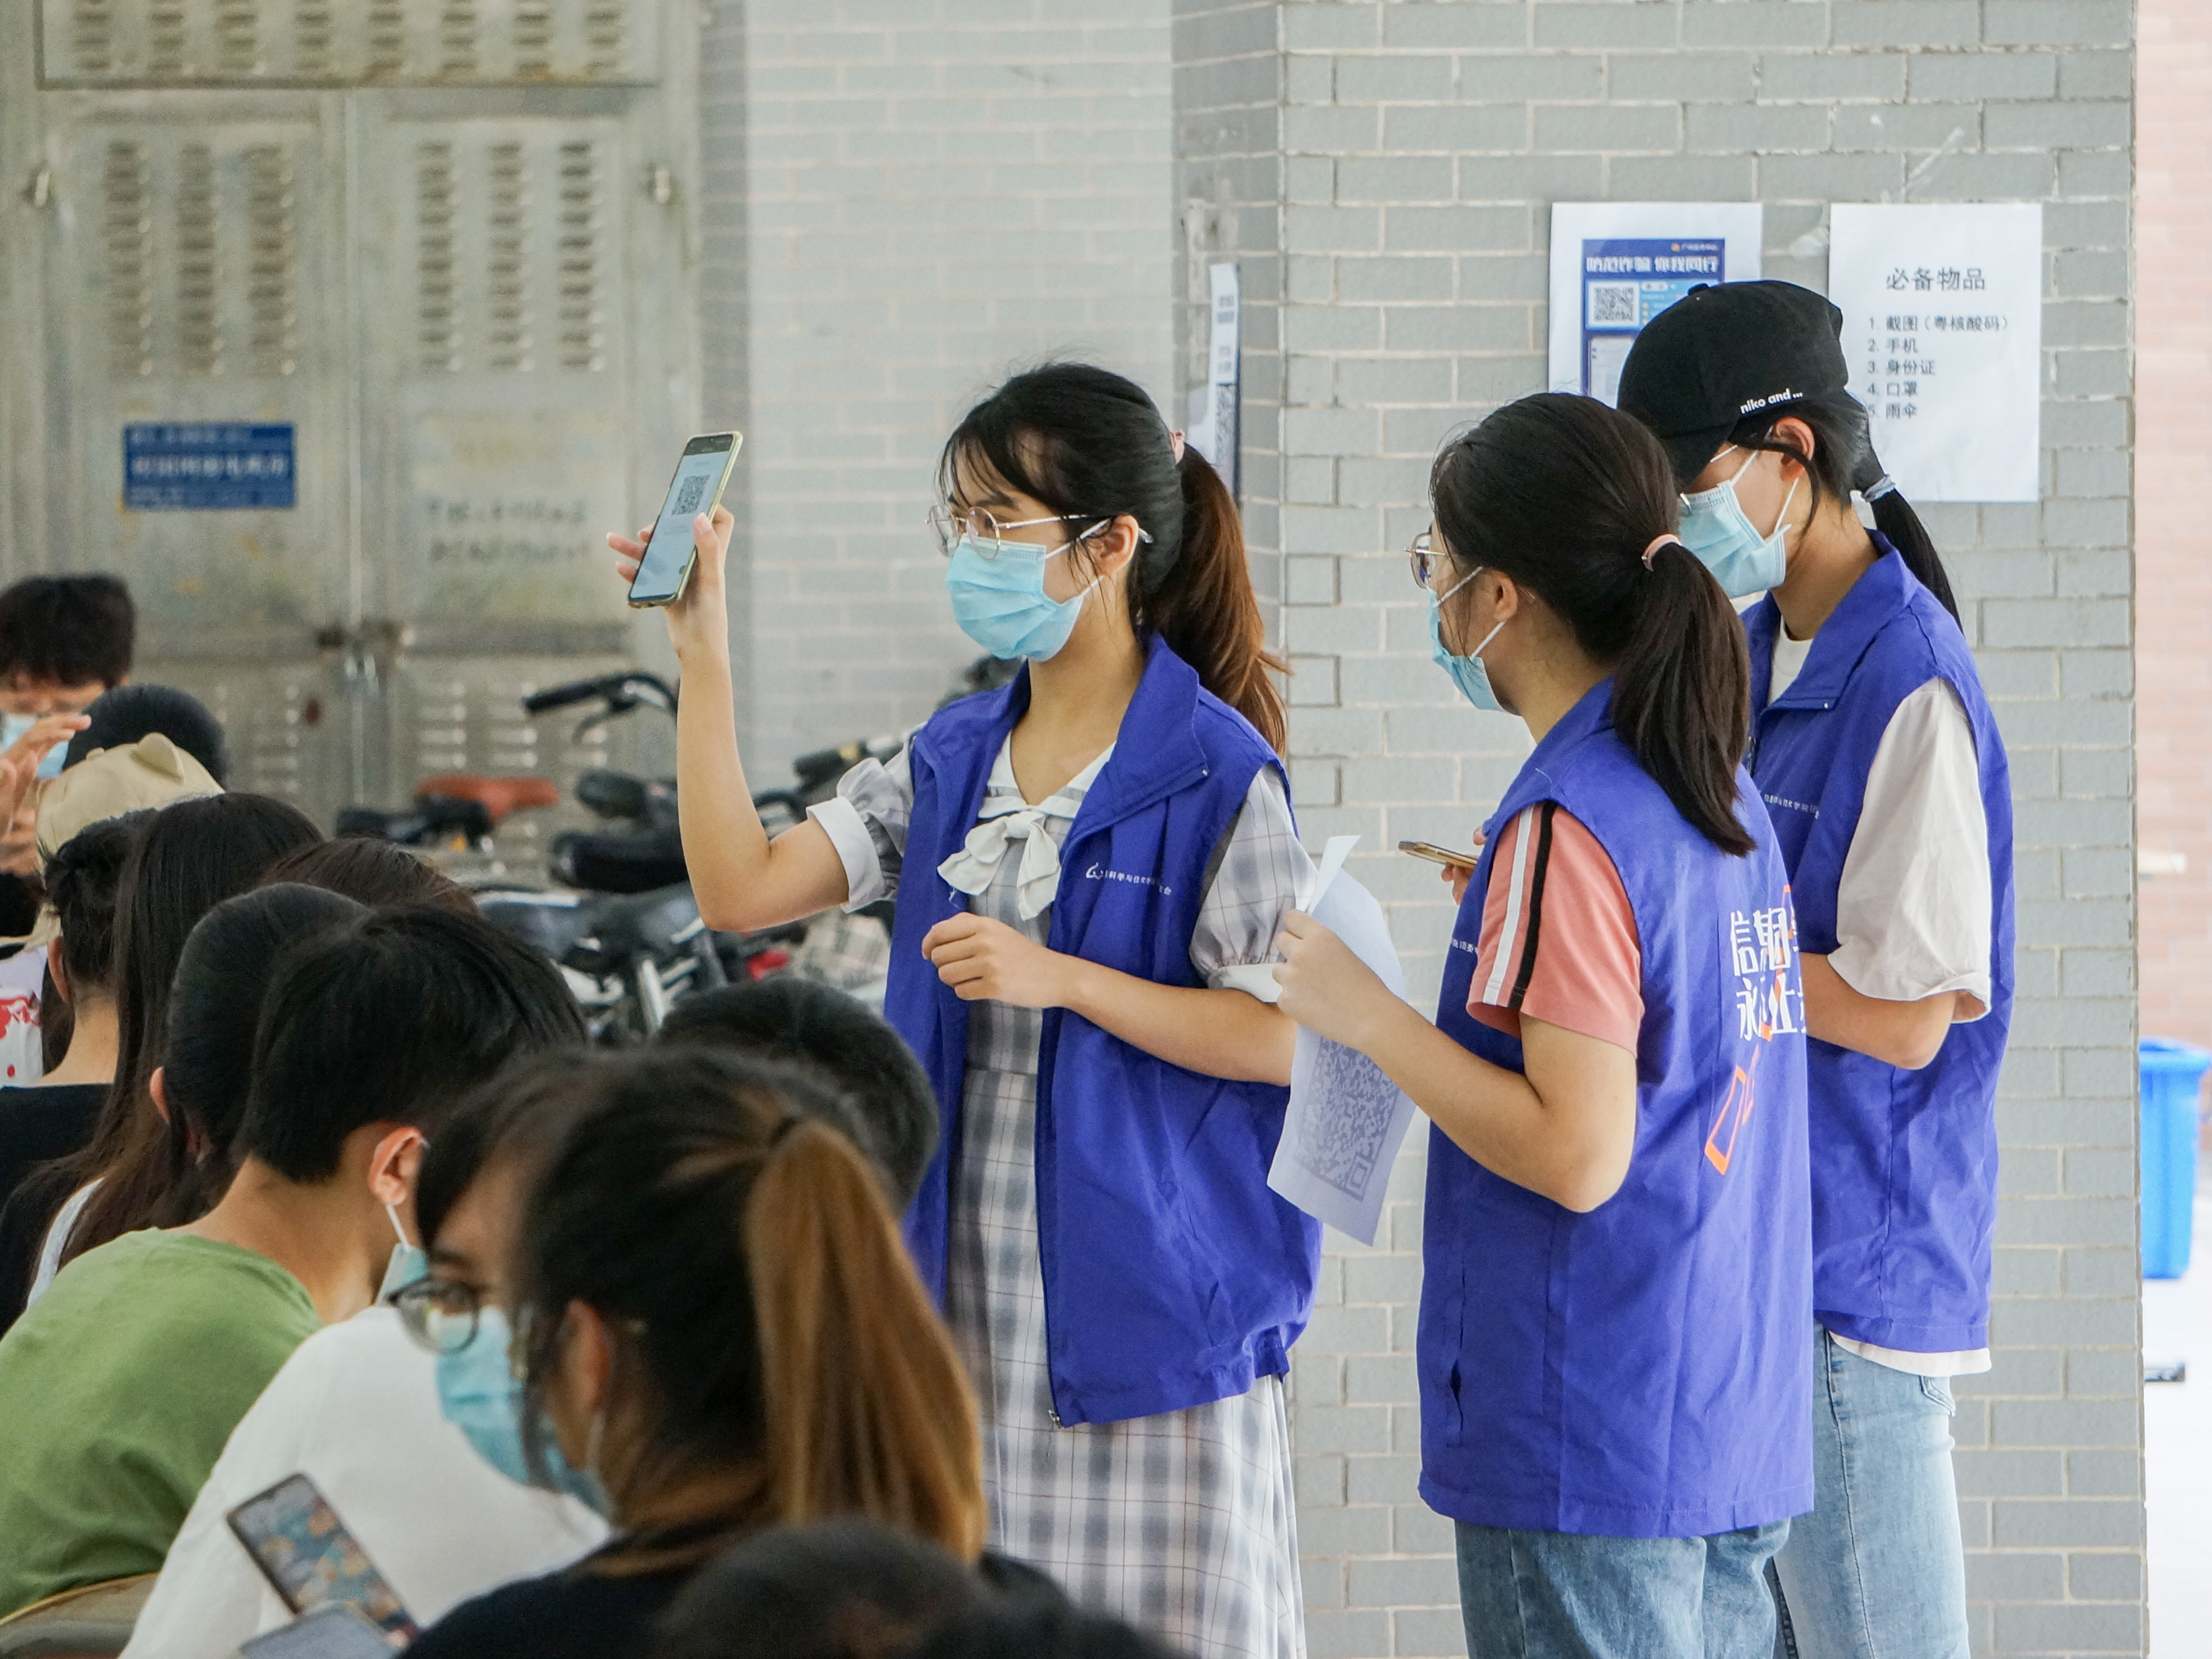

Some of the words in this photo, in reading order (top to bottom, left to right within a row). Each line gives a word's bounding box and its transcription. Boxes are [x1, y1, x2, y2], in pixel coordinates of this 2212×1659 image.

[1885, 266, 1986, 292] 必备物品
[1869, 315, 1879, 330] 1.
[1867, 338, 1879, 353] 2.
[1885, 337, 1918, 355] 手机
[1867, 359, 1879, 375] 3.
[1885, 358, 1936, 376] 身份证
[1768, 388, 1791, 404] and
[1867, 382, 1879, 396] 4.
[1886, 380, 1918, 399] 口罩
[1885, 402, 1918, 420] 雨伞
